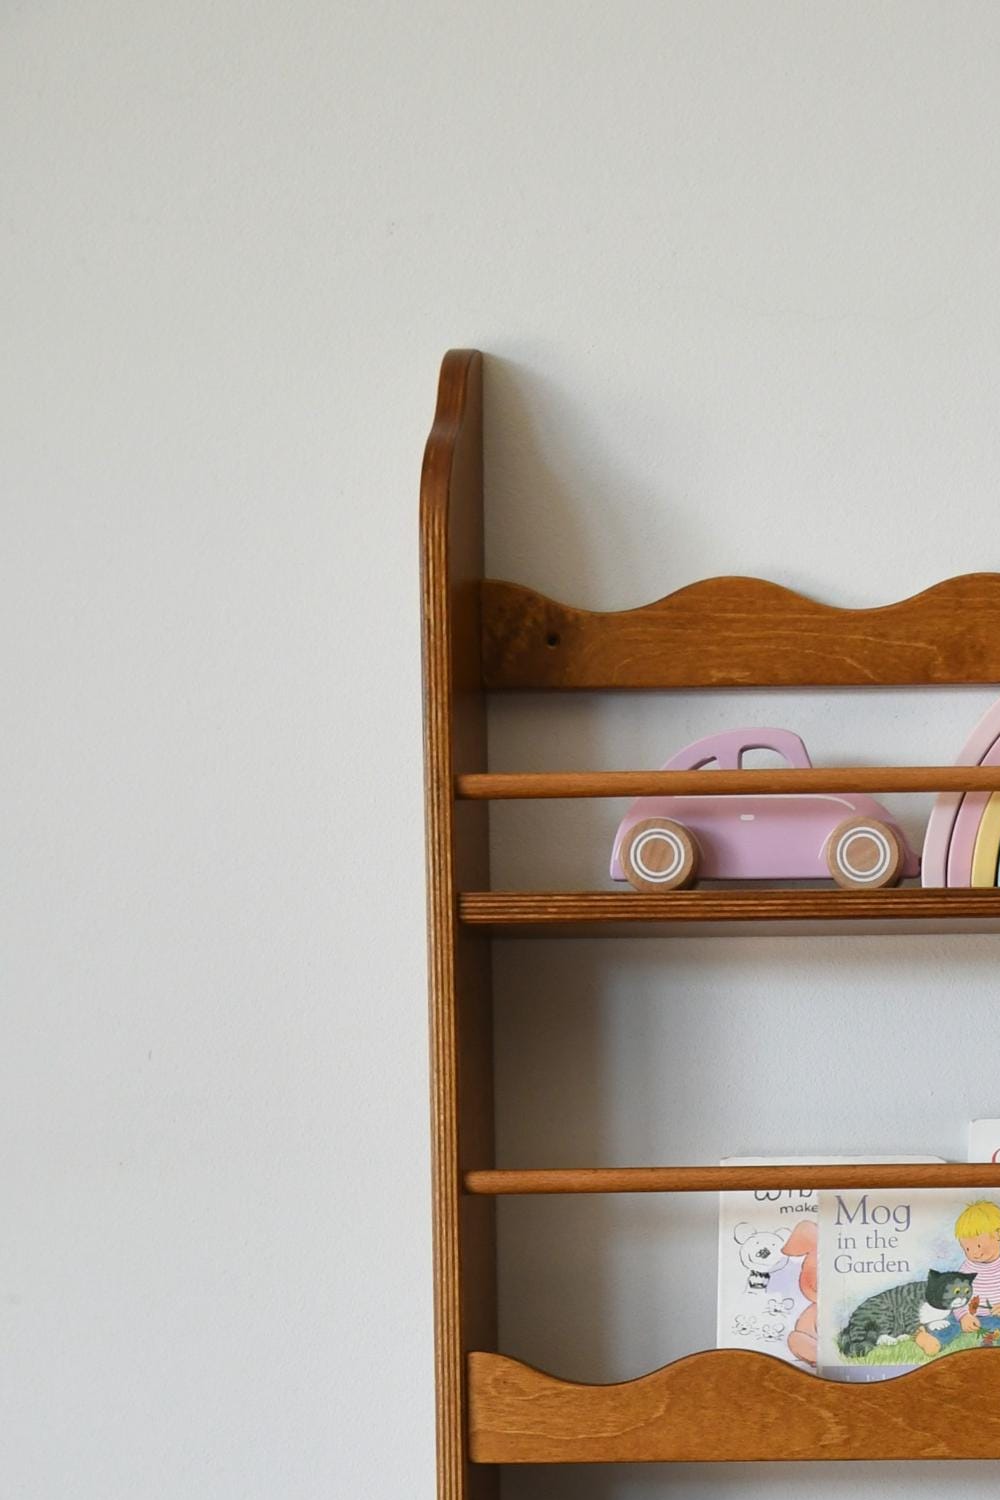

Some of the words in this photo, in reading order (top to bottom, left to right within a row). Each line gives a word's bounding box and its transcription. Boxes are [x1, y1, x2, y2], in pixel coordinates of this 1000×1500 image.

[834, 1194, 911, 1232] Mog
[837, 1232, 857, 1250] in
[866, 1229, 898, 1250] the
[834, 1253, 910, 1274] Garden
